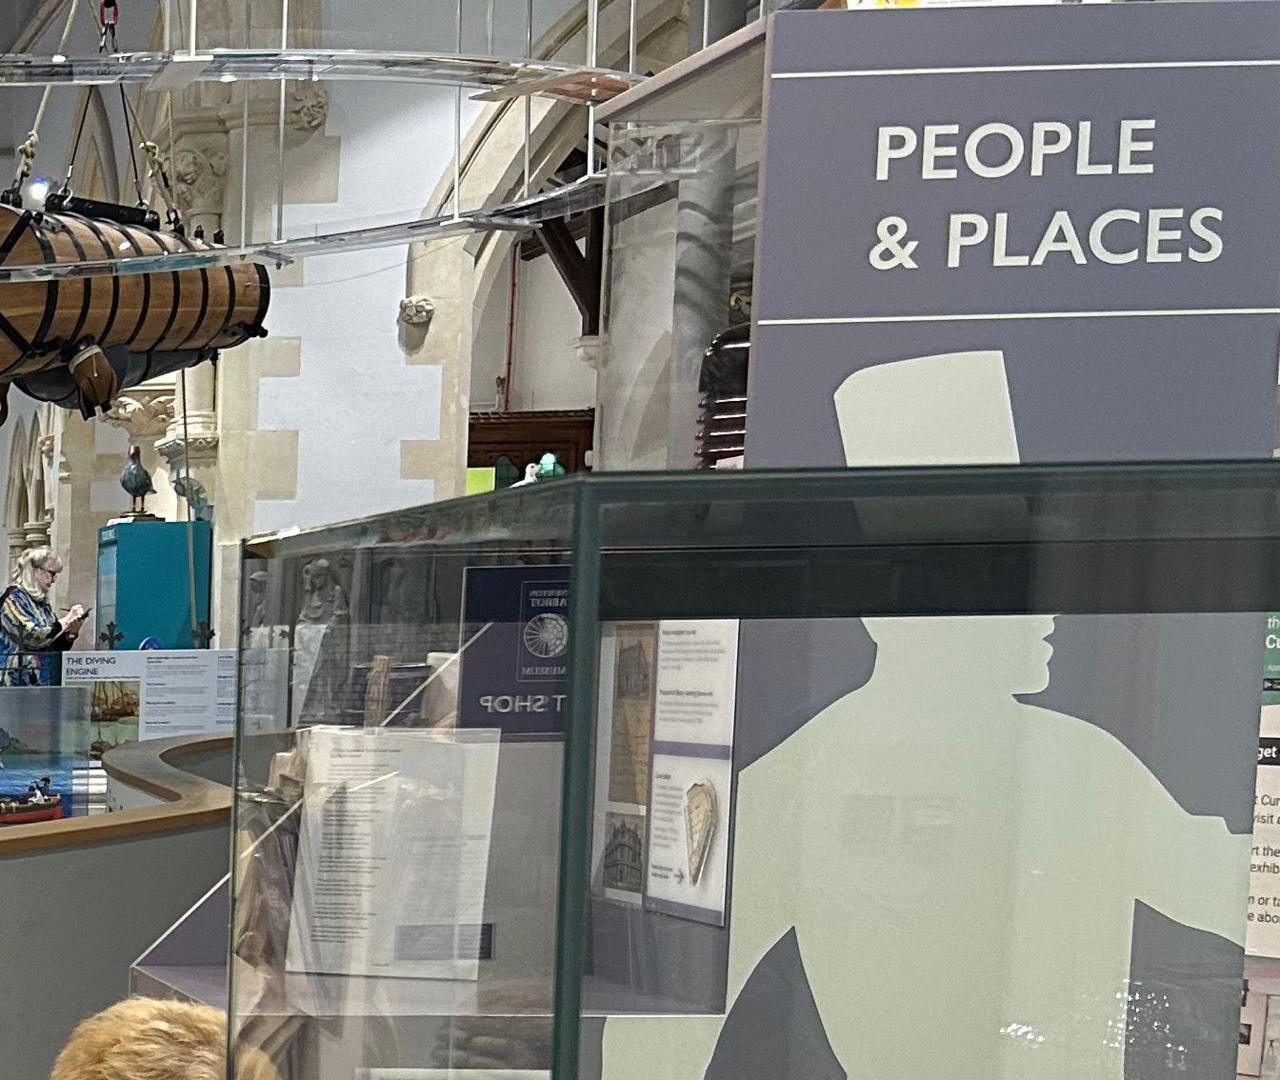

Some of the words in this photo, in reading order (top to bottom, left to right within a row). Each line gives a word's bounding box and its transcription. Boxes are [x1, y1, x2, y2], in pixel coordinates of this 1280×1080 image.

[875, 119, 1156, 181] PEOPLE
[868, 216, 919, 270] &
[946, 207, 1224, 269] PLACES
[66, 657, 83, 665] THE
[85, 656, 116, 665] DIVING
[66, 667, 98, 676] ENGINE
